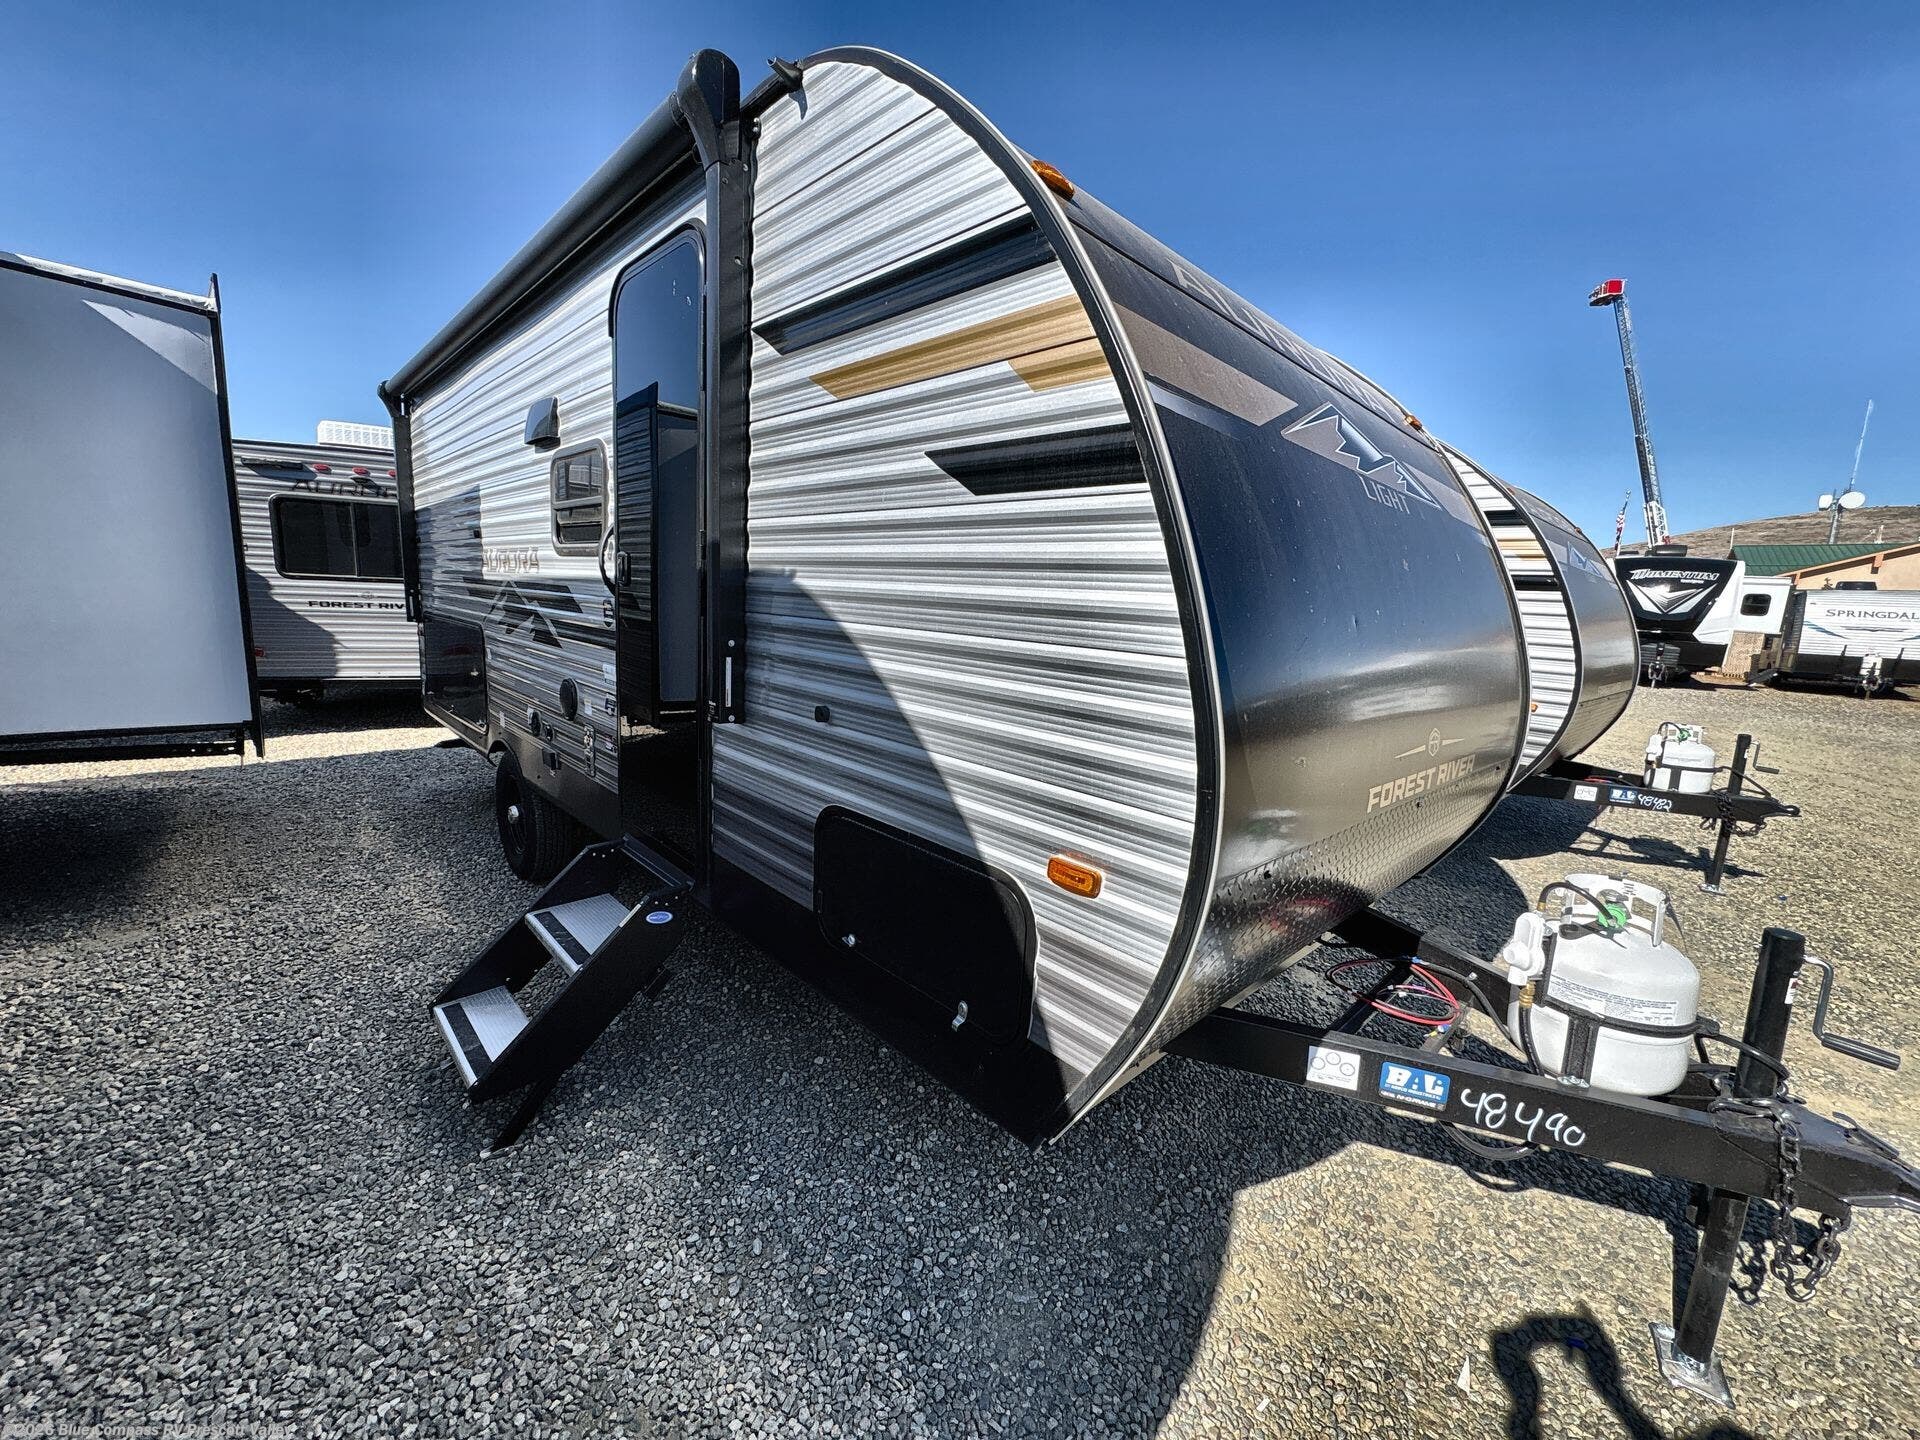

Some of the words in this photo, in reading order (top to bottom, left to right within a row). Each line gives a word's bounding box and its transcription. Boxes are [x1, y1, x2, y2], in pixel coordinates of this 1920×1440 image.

[1357, 473, 1410, 514] LIGHT
[482, 546, 540, 574] AURORA
[1629, 568, 1720, 581] MOMENTUM
[307, 600, 375, 609] FOREST
[1825, 609, 1920, 620] SPRINGDAL
[1366, 766, 1438, 814] FOREST
[1436, 754, 1477, 786] RIVER
[1460, 1088, 1586, 1147] 48490
